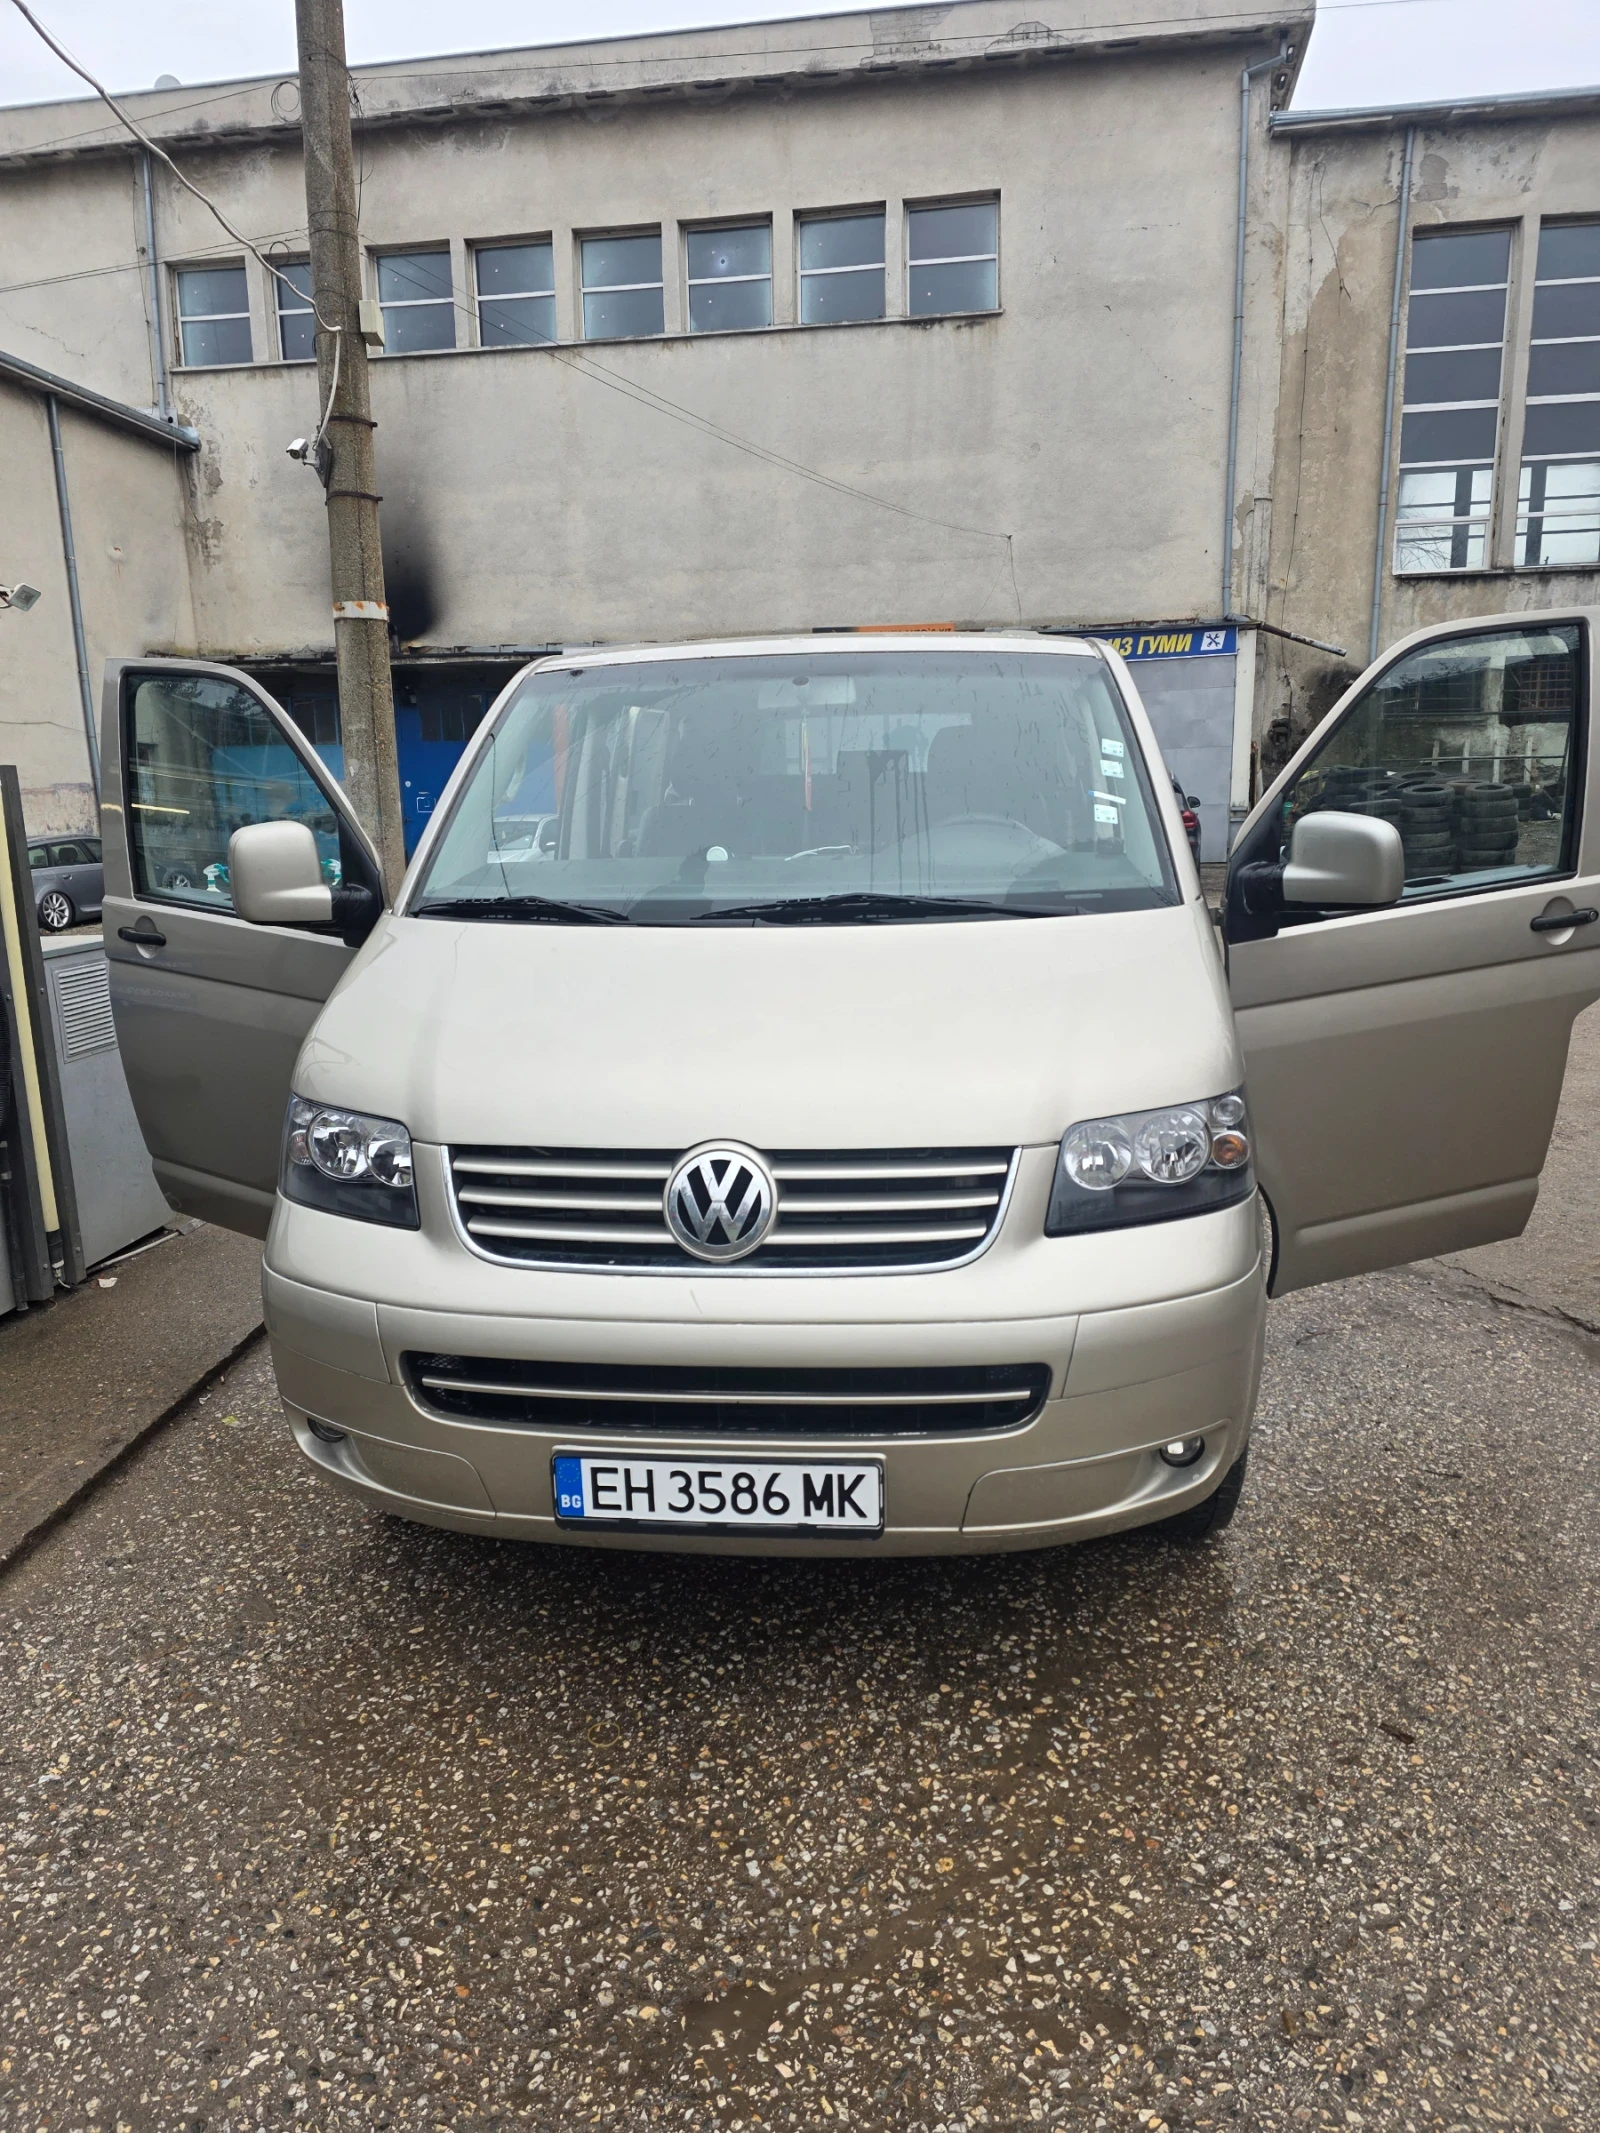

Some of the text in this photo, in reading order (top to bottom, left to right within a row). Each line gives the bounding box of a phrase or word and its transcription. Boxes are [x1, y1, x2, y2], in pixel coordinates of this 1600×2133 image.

[1136, 633, 1193, 655] ГУМИ
[672, 1154, 767, 1252] VW
[561, 1494, 582, 1509] BG
[590, 1466, 868, 1519] EH 3586 MK
